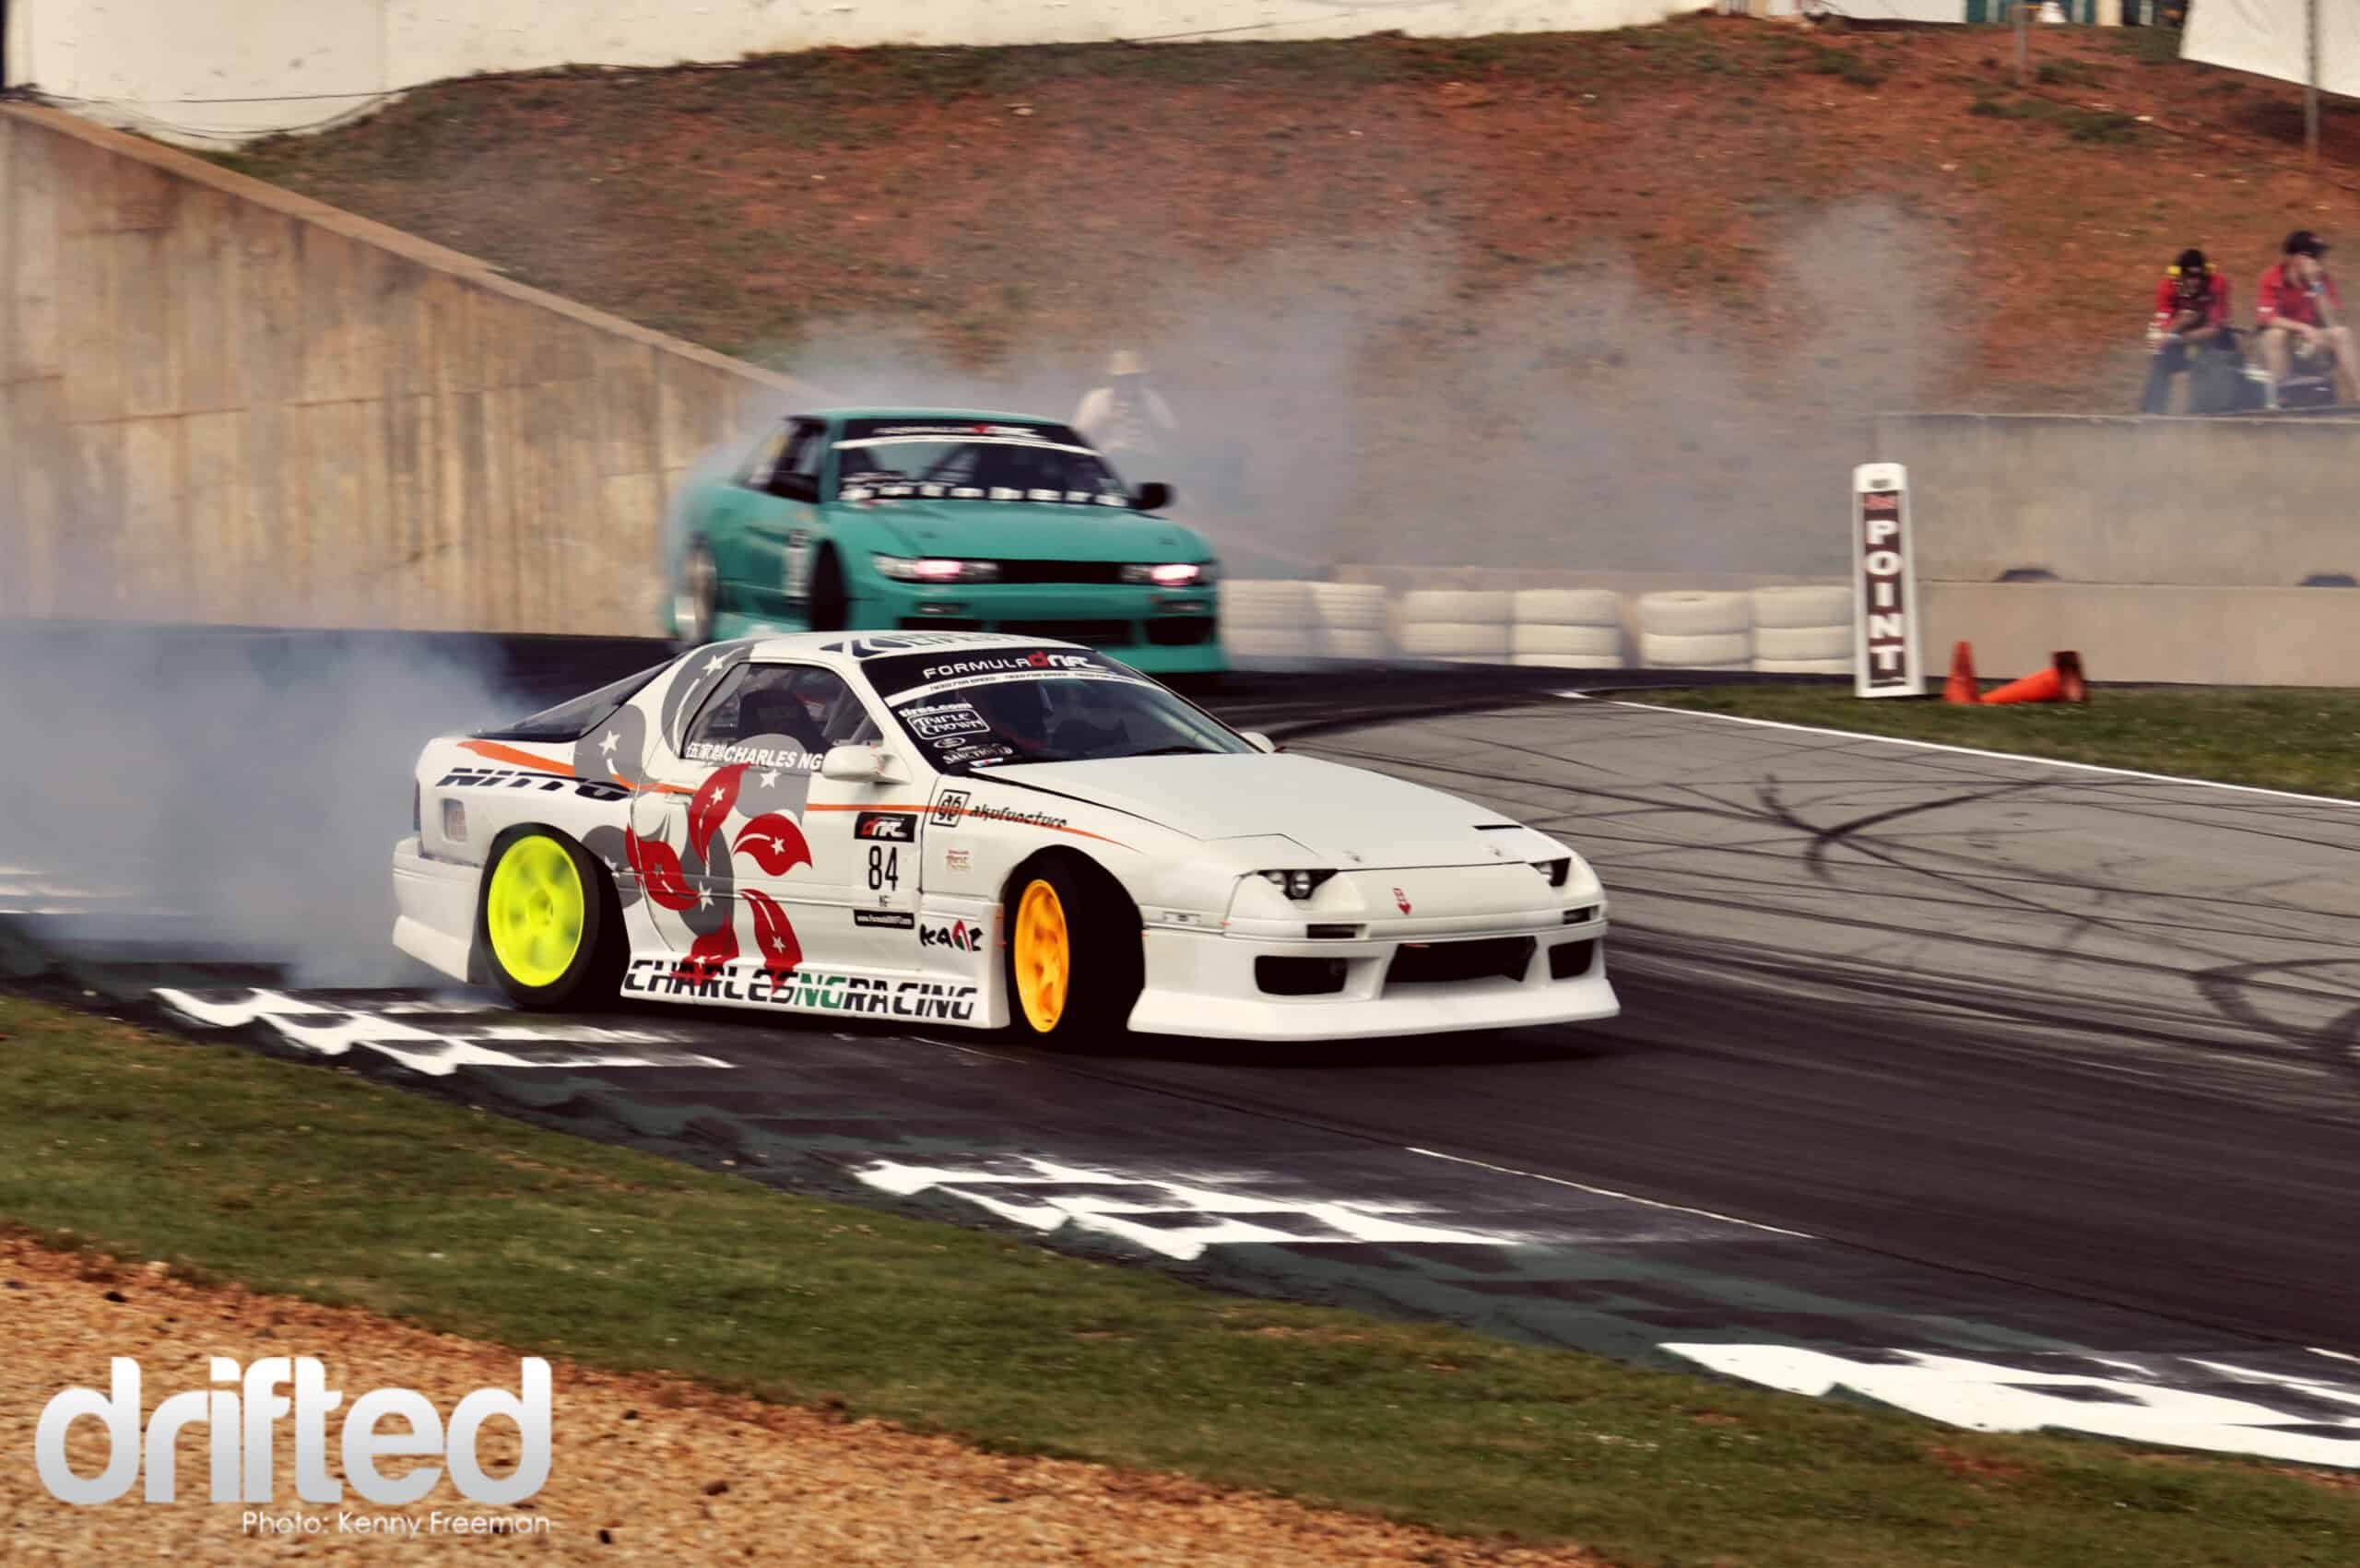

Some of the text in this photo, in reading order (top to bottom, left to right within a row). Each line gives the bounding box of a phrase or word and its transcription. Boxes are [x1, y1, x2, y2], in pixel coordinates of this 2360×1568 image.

[1866, 520, 1903, 670] POINT
[723, 746, 823, 770] CHARLES NG
[435, 767, 631, 801] NITTO
[867, 845, 899, 891] 84
